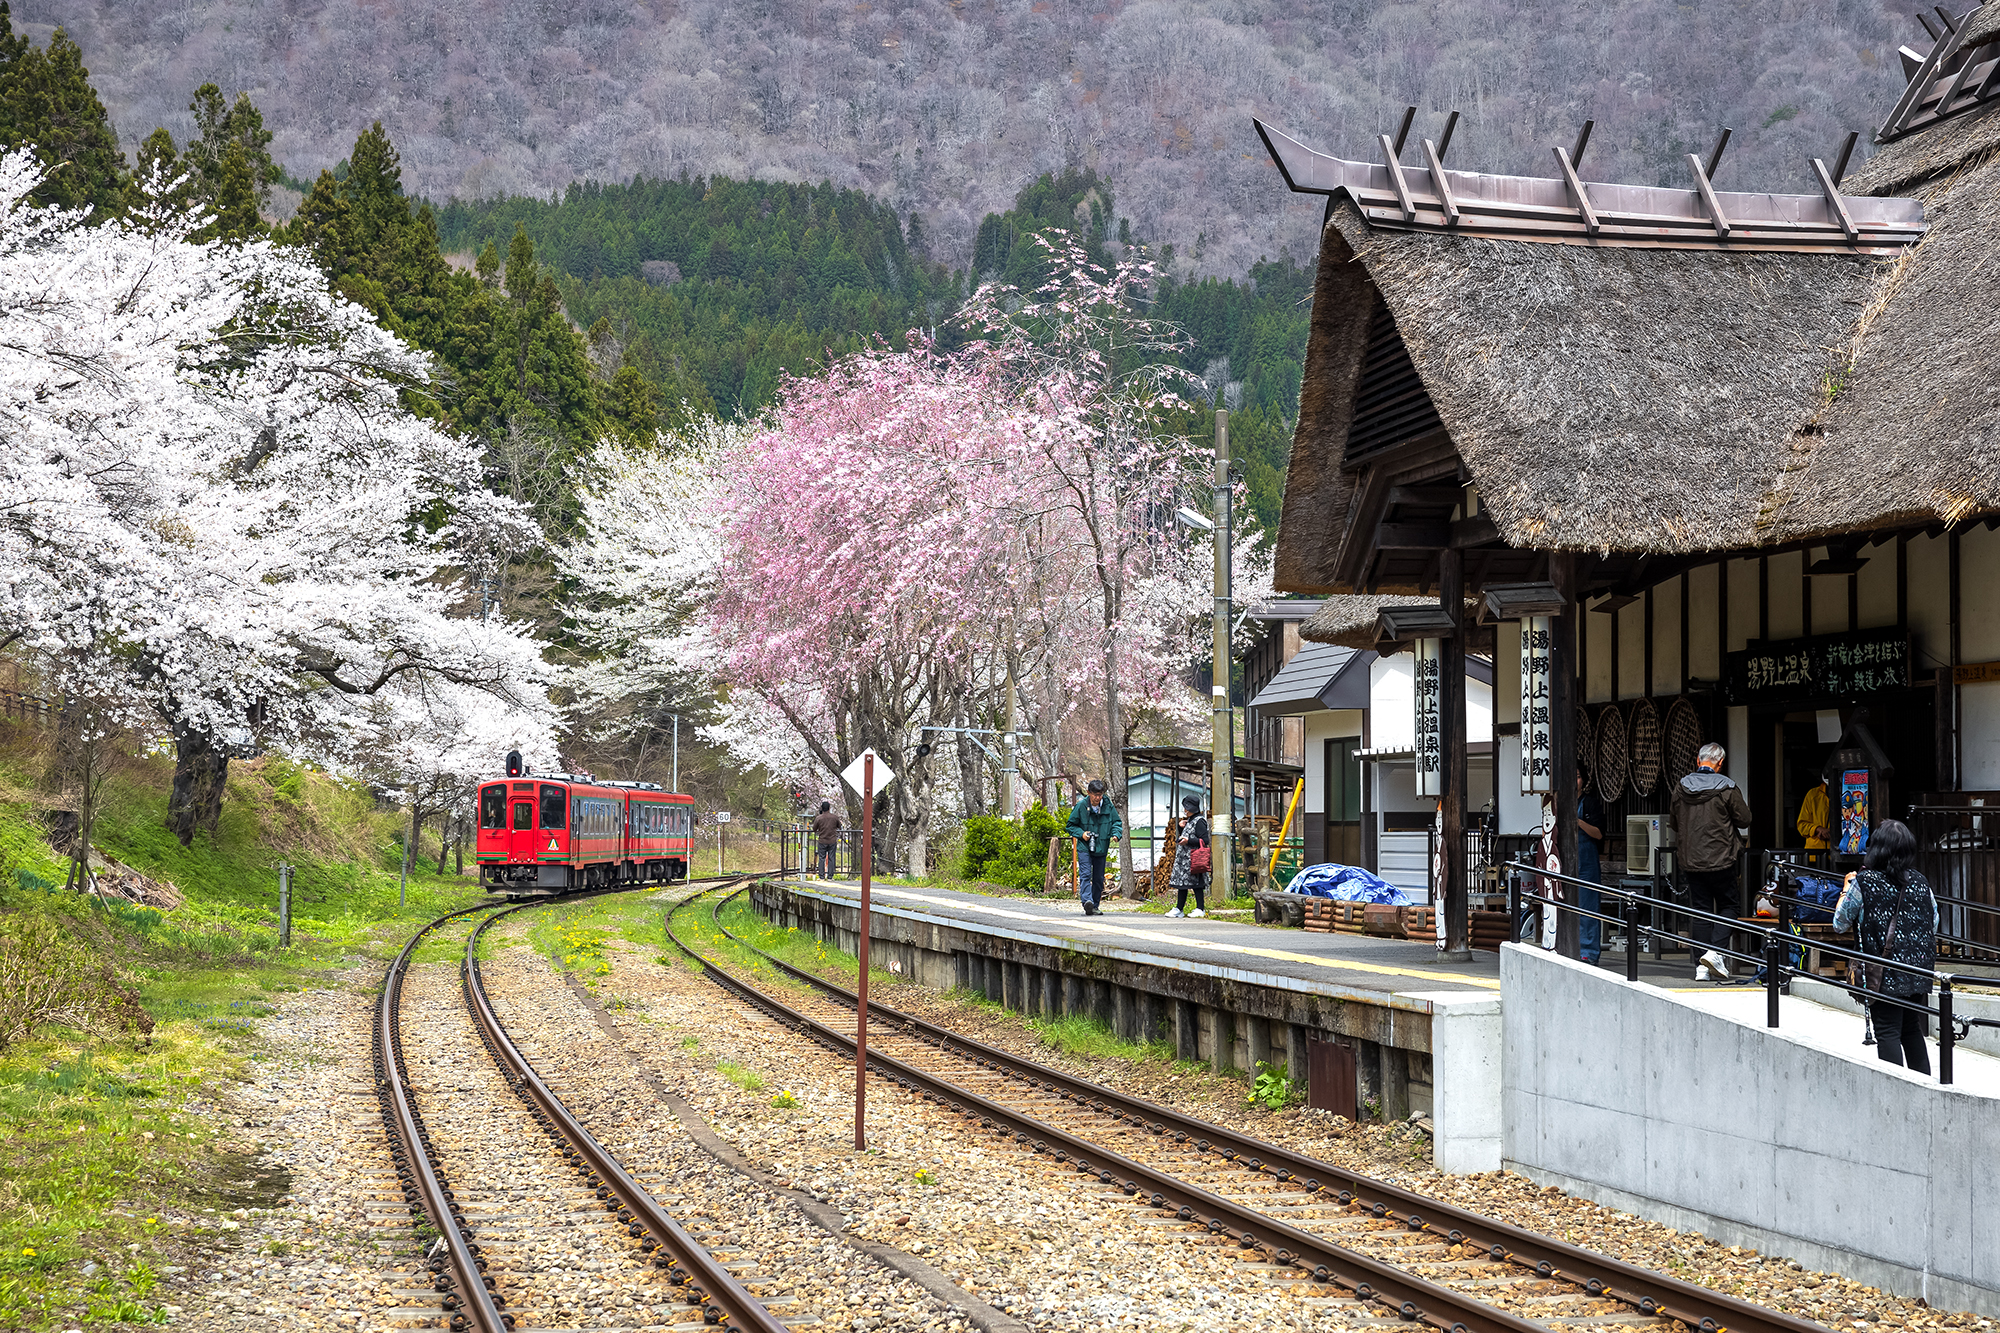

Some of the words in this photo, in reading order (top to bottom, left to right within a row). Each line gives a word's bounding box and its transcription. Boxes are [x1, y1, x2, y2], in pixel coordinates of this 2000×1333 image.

[1531, 629, 1550, 777] 湯野上温泉駅
[1748, 651, 1812, 690] 湯野上温泉
[1424, 658, 1440, 773] 湯野上温泉駅
[719, 813, 730, 821] 60
